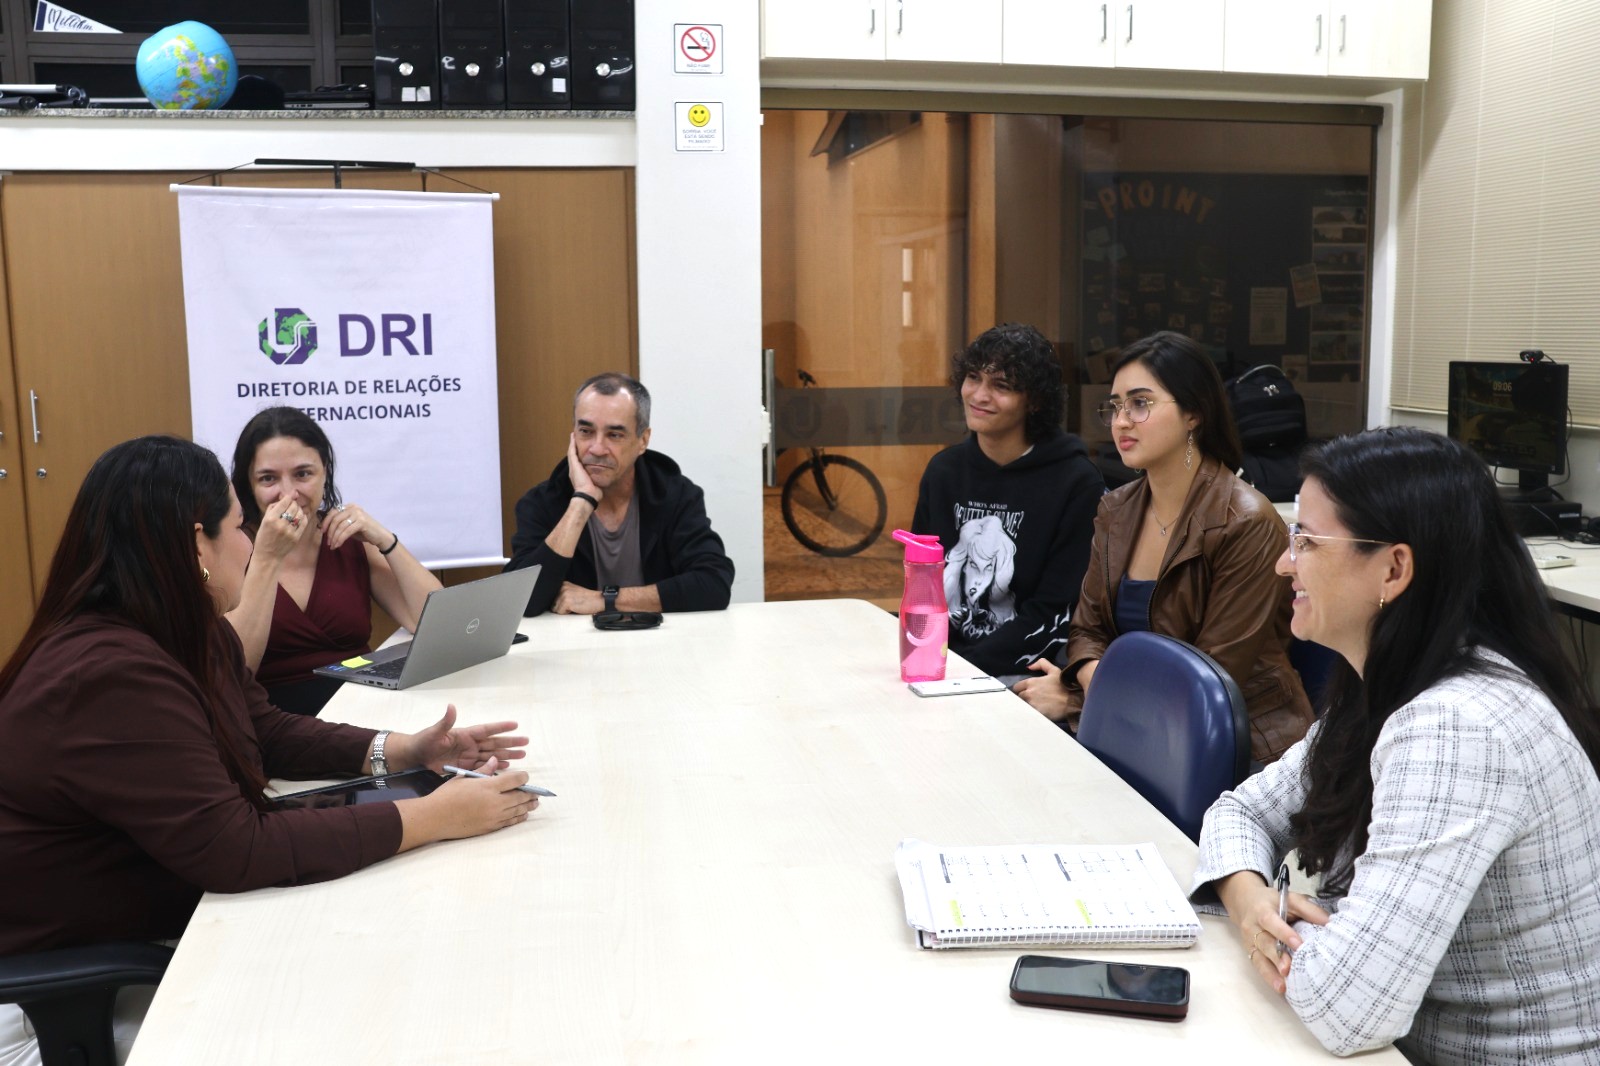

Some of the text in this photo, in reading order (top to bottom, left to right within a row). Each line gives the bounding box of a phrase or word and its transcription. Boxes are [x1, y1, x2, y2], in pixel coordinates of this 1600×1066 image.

[338, 313, 433, 357] DRI
[237, 375, 461, 398] DIRETORIA DE RELAÇÕES
[298, 403, 431, 421] ERNACIONAIS
